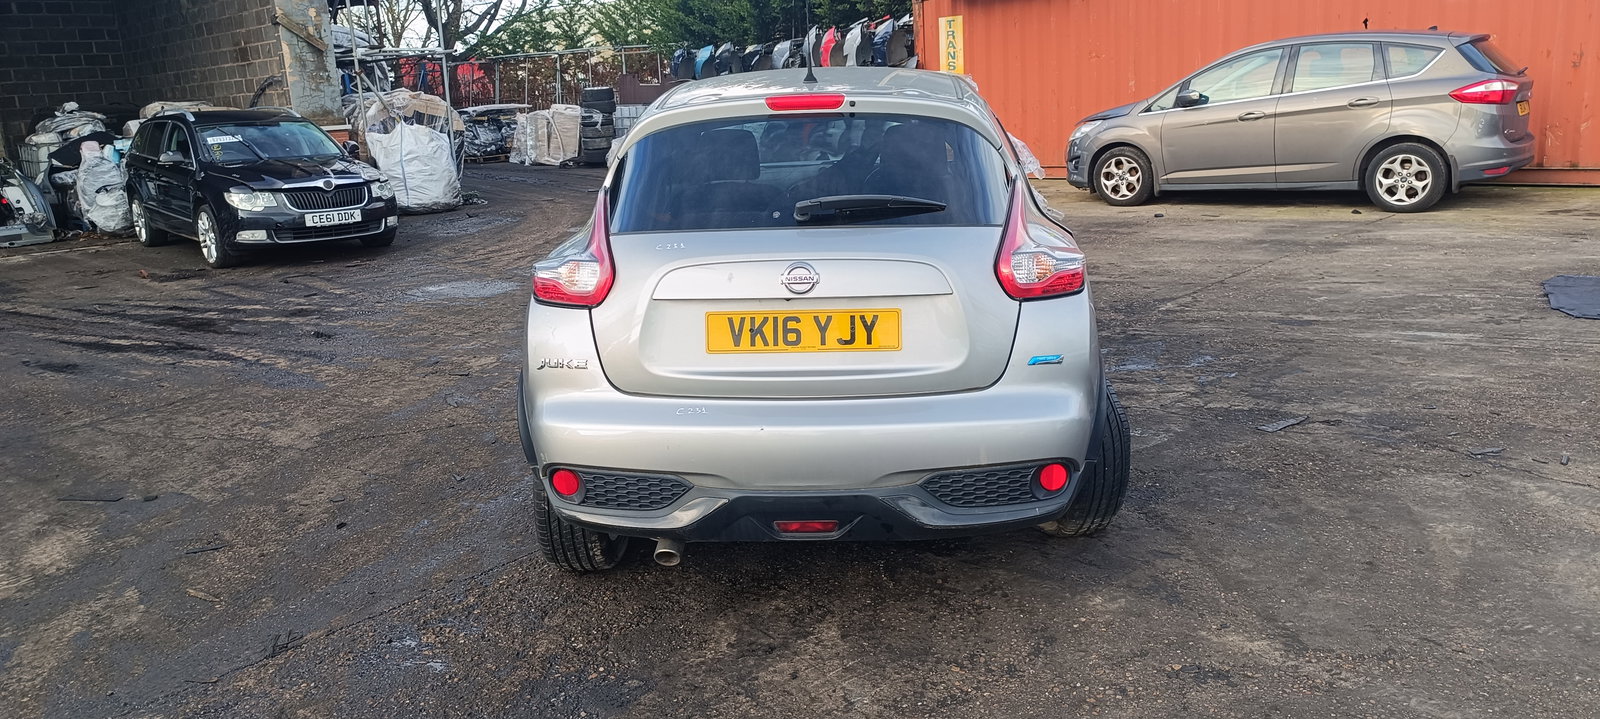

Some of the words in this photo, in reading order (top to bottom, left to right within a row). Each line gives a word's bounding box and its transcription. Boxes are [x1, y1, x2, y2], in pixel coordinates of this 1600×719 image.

[946, 19, 955, 71] TRANS
[311, 214, 335, 224] CE61
[338, 211, 356, 222] DDK
[727, 315, 802, 347] VK16
[813, 314, 879, 346] YJY
[536, 357, 588, 370] JUKE
[676, 407, 684, 415] C
